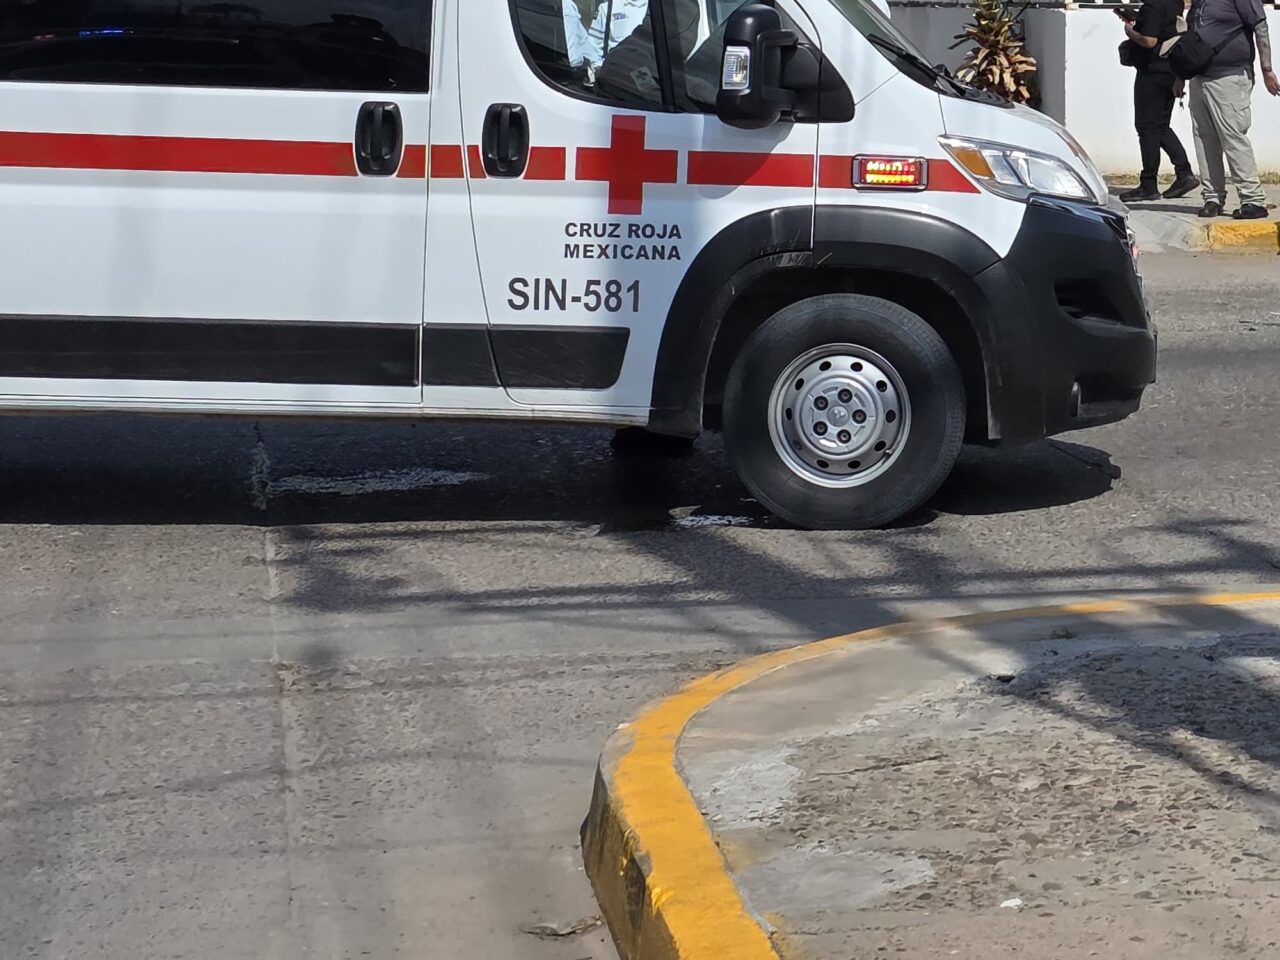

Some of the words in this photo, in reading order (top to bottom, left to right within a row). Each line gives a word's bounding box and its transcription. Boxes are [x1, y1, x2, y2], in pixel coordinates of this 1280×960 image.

[564, 222, 621, 238] CRUZ
[628, 223, 682, 239] ROJA
[564, 244, 681, 260] MEXICANA
[507, 277, 640, 313] SIN-581
